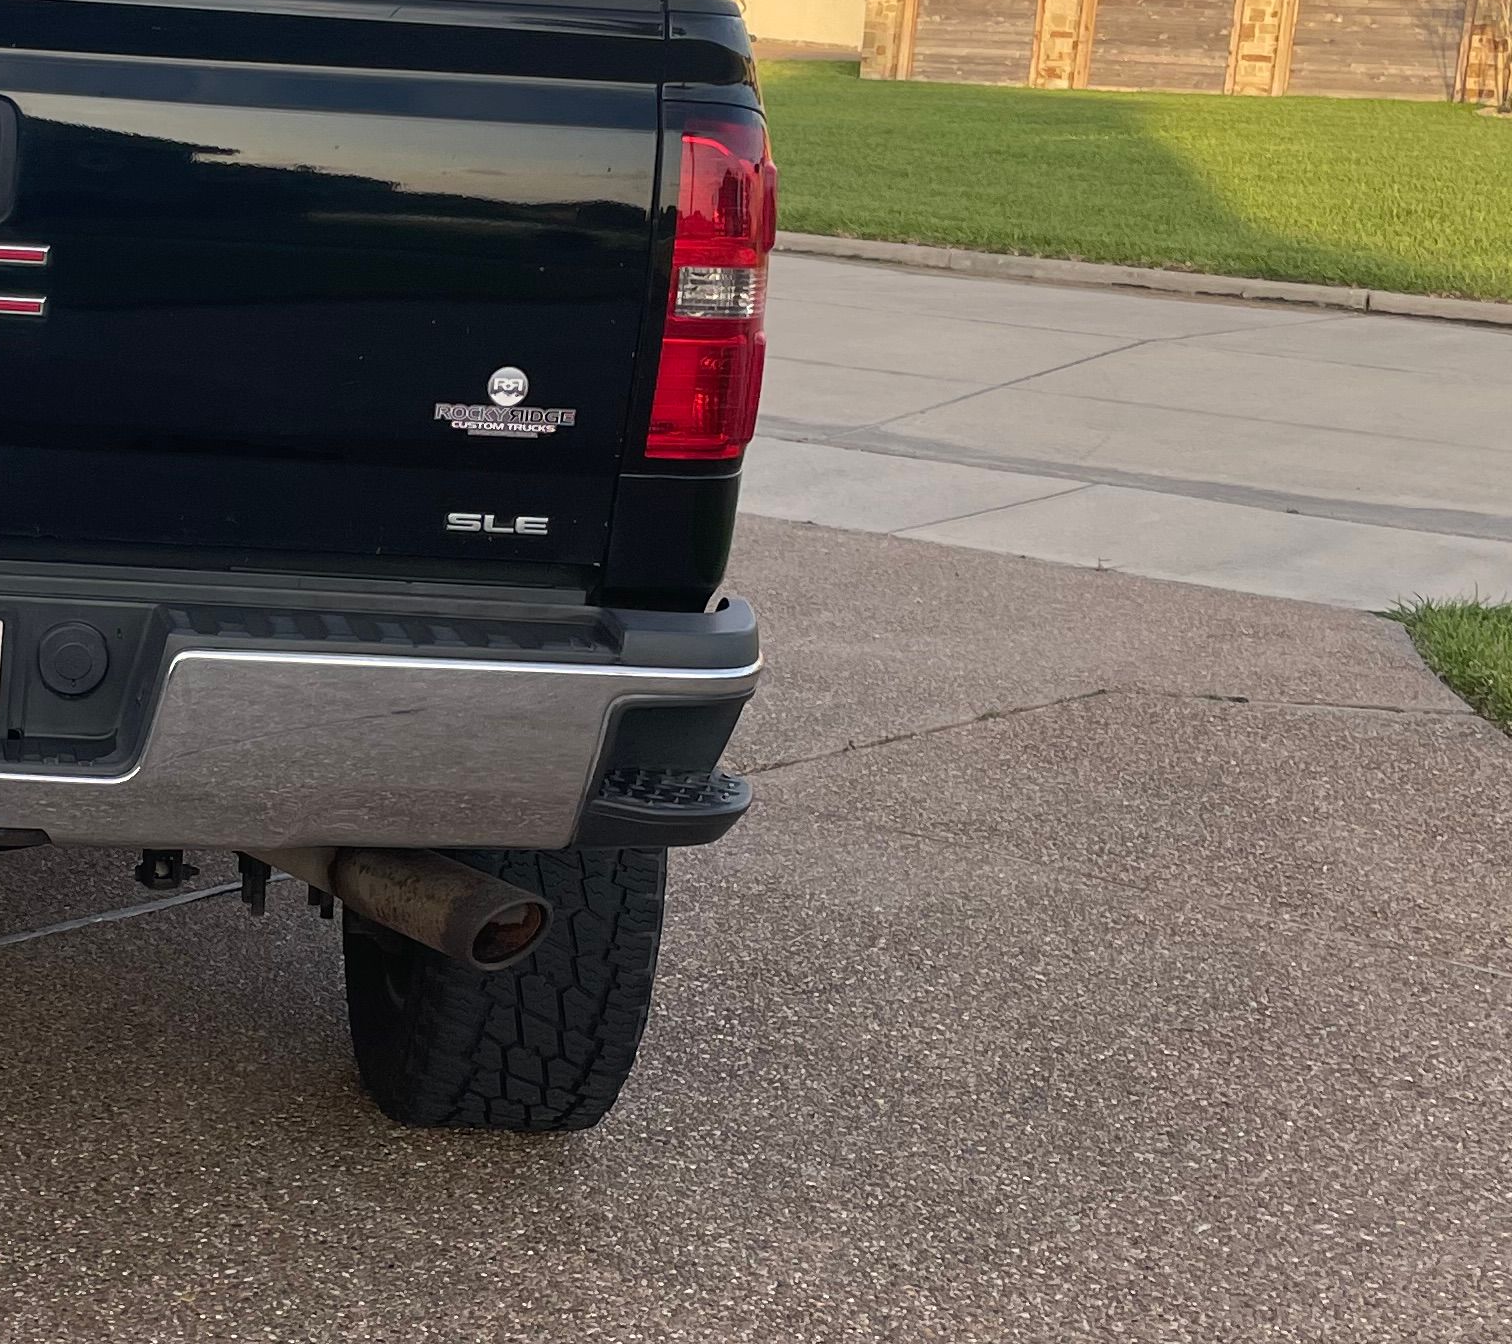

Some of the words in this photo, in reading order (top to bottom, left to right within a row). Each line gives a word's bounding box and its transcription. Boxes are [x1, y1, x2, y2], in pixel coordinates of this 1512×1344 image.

[451, 420, 505, 431] CUSTOM
[506, 422, 557, 434] TRUCKS
[446, 512, 549, 536] SLE
